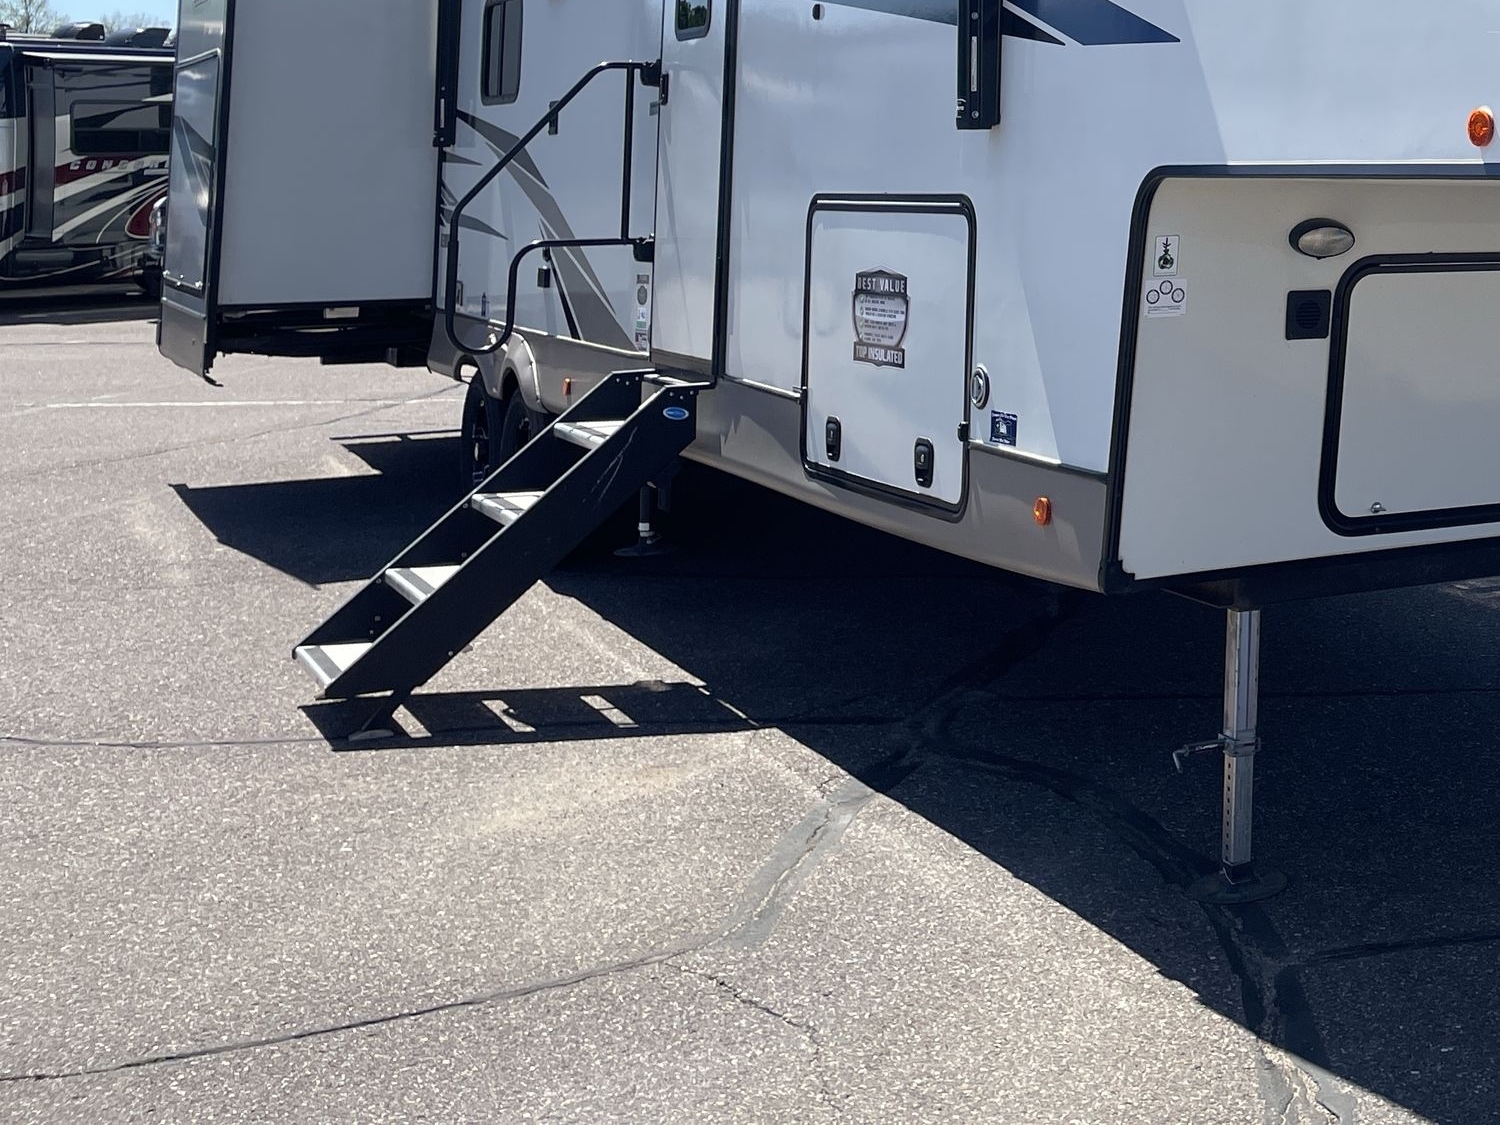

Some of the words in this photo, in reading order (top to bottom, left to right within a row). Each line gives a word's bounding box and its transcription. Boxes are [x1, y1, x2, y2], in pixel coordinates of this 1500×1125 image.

[857, 276, 877, 291] BEST
[880, 278, 905, 293] VALUE
[868, 347, 903, 365] INSULATED
